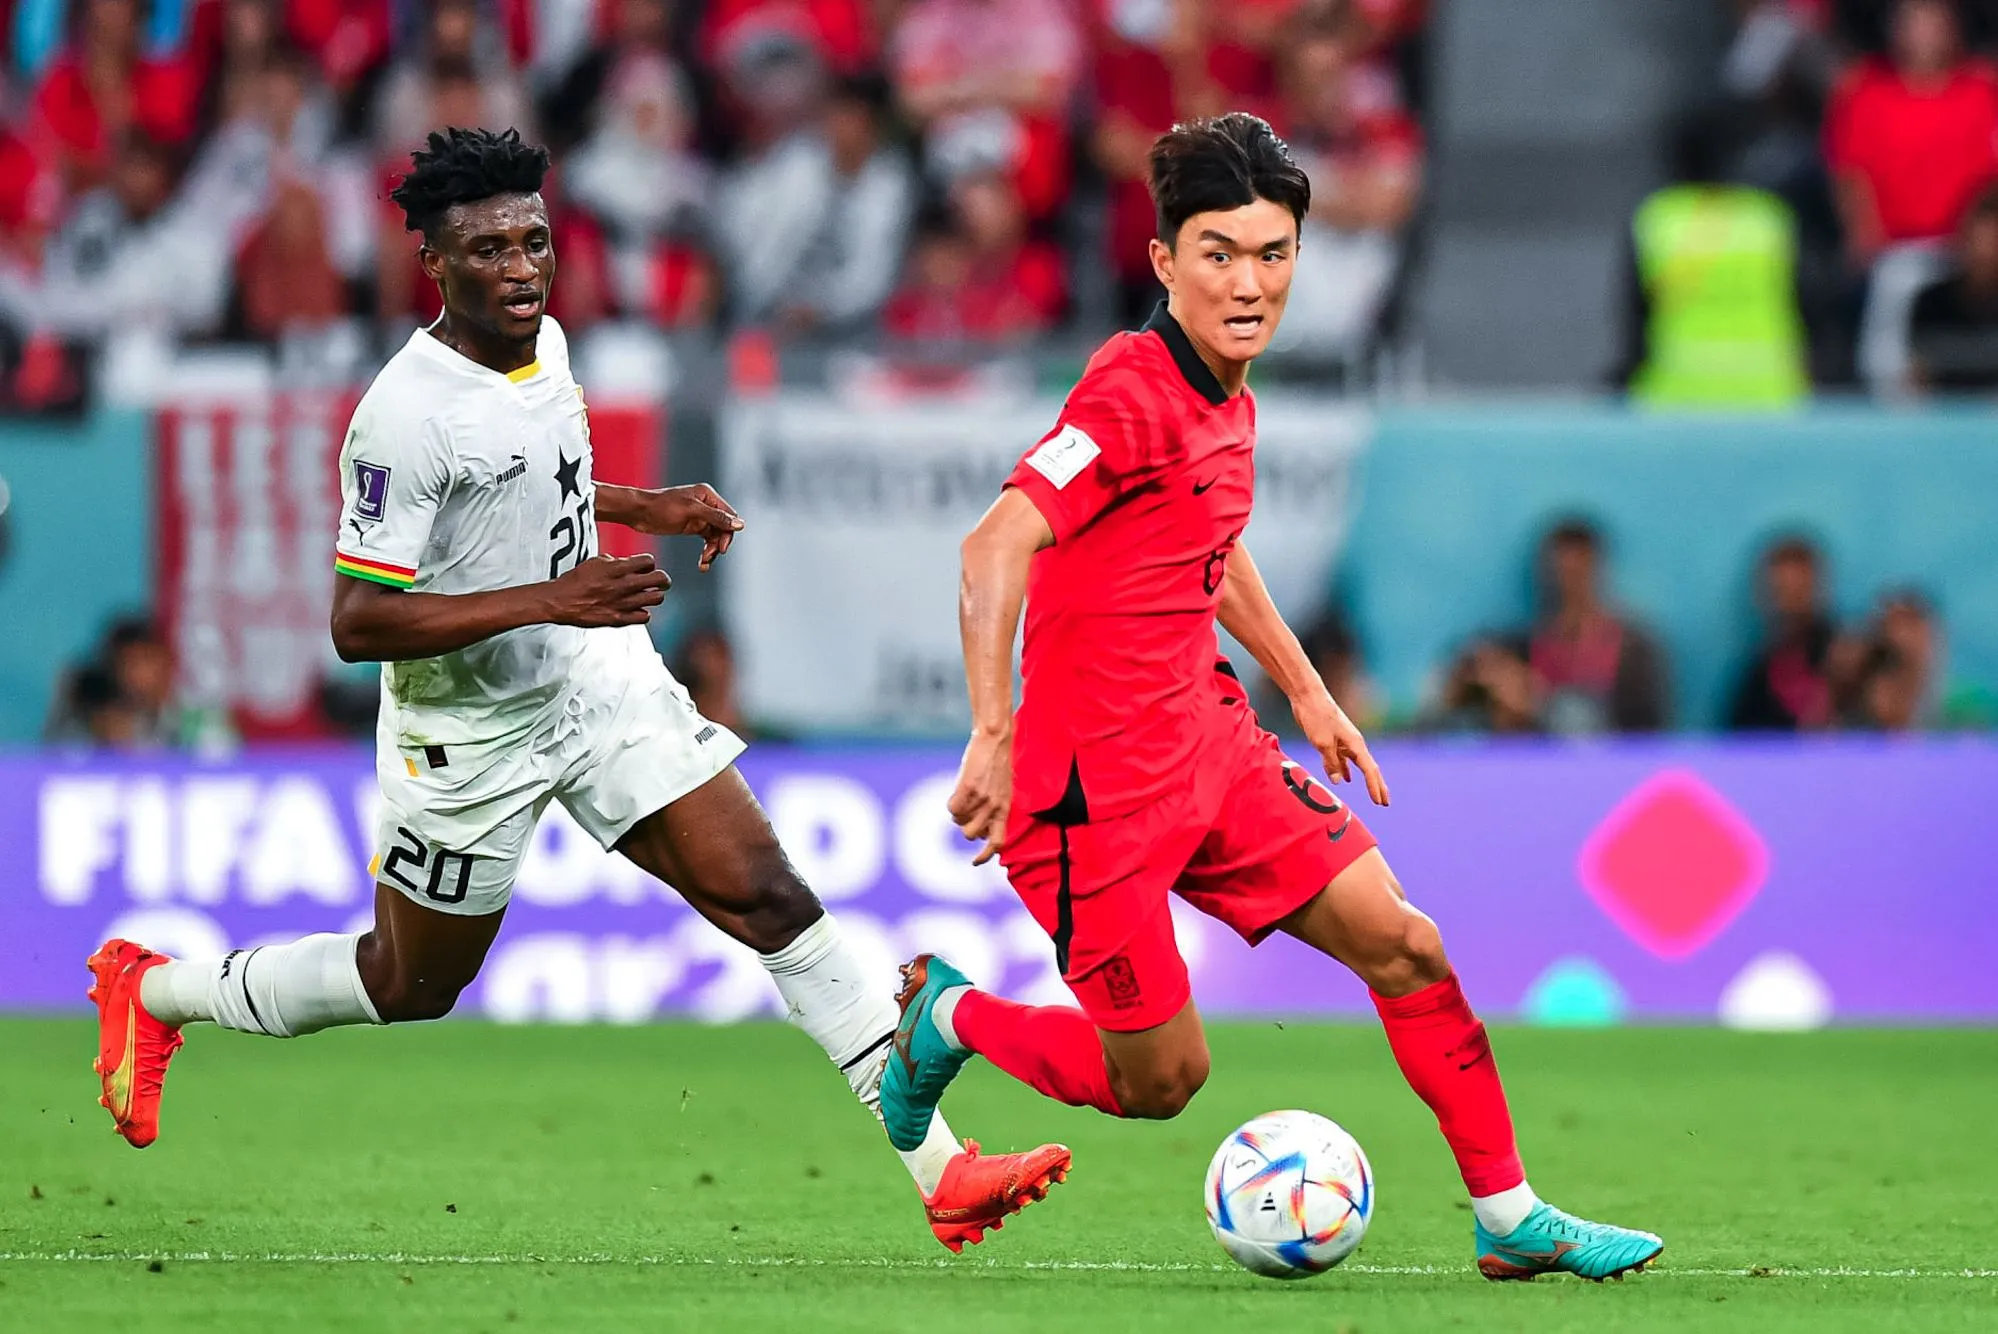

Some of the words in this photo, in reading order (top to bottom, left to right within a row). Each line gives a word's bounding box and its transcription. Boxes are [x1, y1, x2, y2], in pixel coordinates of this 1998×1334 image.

[496, 461, 526, 485] PUMA
[1281, 761, 1342, 814] 6
[38, 772, 361, 906] FIFA
[383, 826, 474, 904] 20
